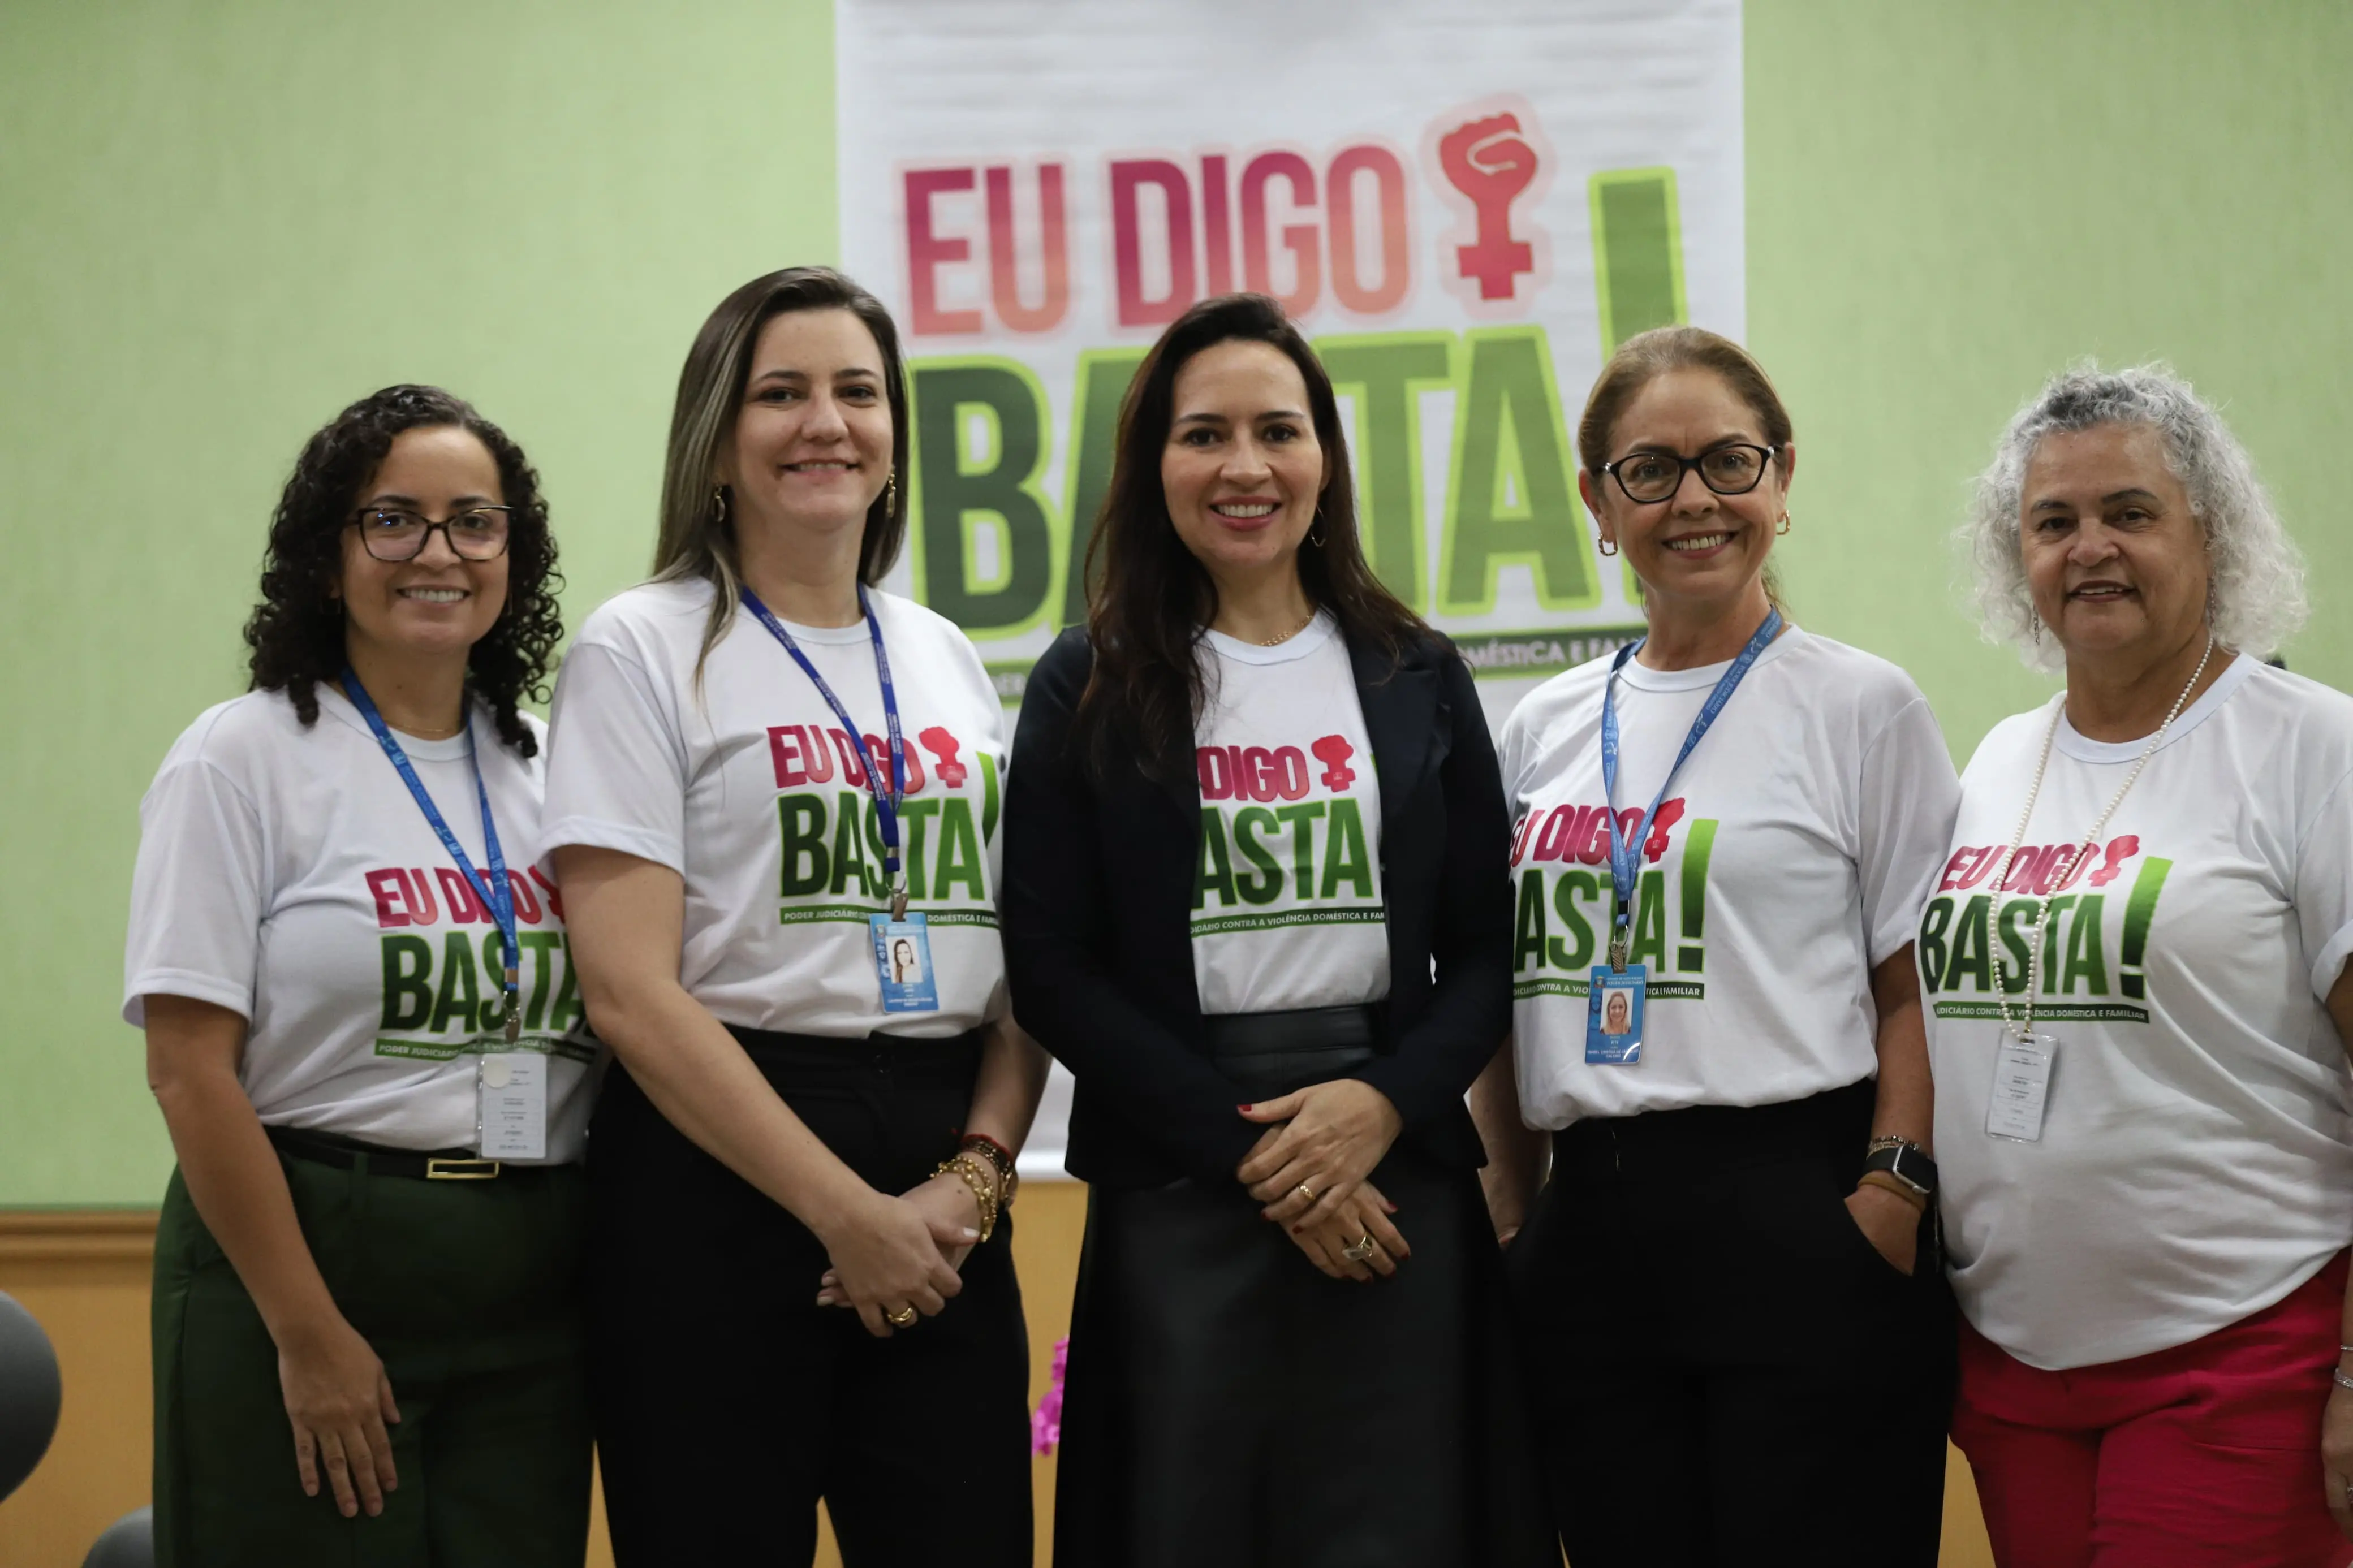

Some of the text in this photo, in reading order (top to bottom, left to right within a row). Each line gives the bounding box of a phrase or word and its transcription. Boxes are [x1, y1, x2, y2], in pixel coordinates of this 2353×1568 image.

[903, 145, 1409, 335] EU DIGO
[905, 166, 1688, 639] BTA
[766, 724, 834, 788] EU
[826, 728, 925, 795] DGO
[1196, 745, 1310, 802] DIGO
[1190, 798, 1374, 911] ASTA
[1532, 804, 1645, 865] DIGO
[365, 867, 439, 928] EU
[433, 867, 542, 925] DO
[1513, 818, 1720, 974] ASTA!
[1936, 842, 2101, 896] EU DIGO
[784, 911, 815, 921] PODER
[1222, 919, 1257, 929] CONTRA
[1267, 913, 1311, 926] VIOLÊNCIA
[1313, 910, 1361, 921] DOMÉSTICA
[1919, 856, 2174, 1000] BASTA!
[378, 930, 600, 1034] BASTA
[1563, 984, 1570, 993] A
[1663, 986, 1700, 996] FAMILIAR
[2017, 1007, 2055, 1017] VILÊNCIA
[2056, 1008, 2096, 1017] DOMÉSTICA
[2106, 1009, 2145, 1020] FAMILIAR
